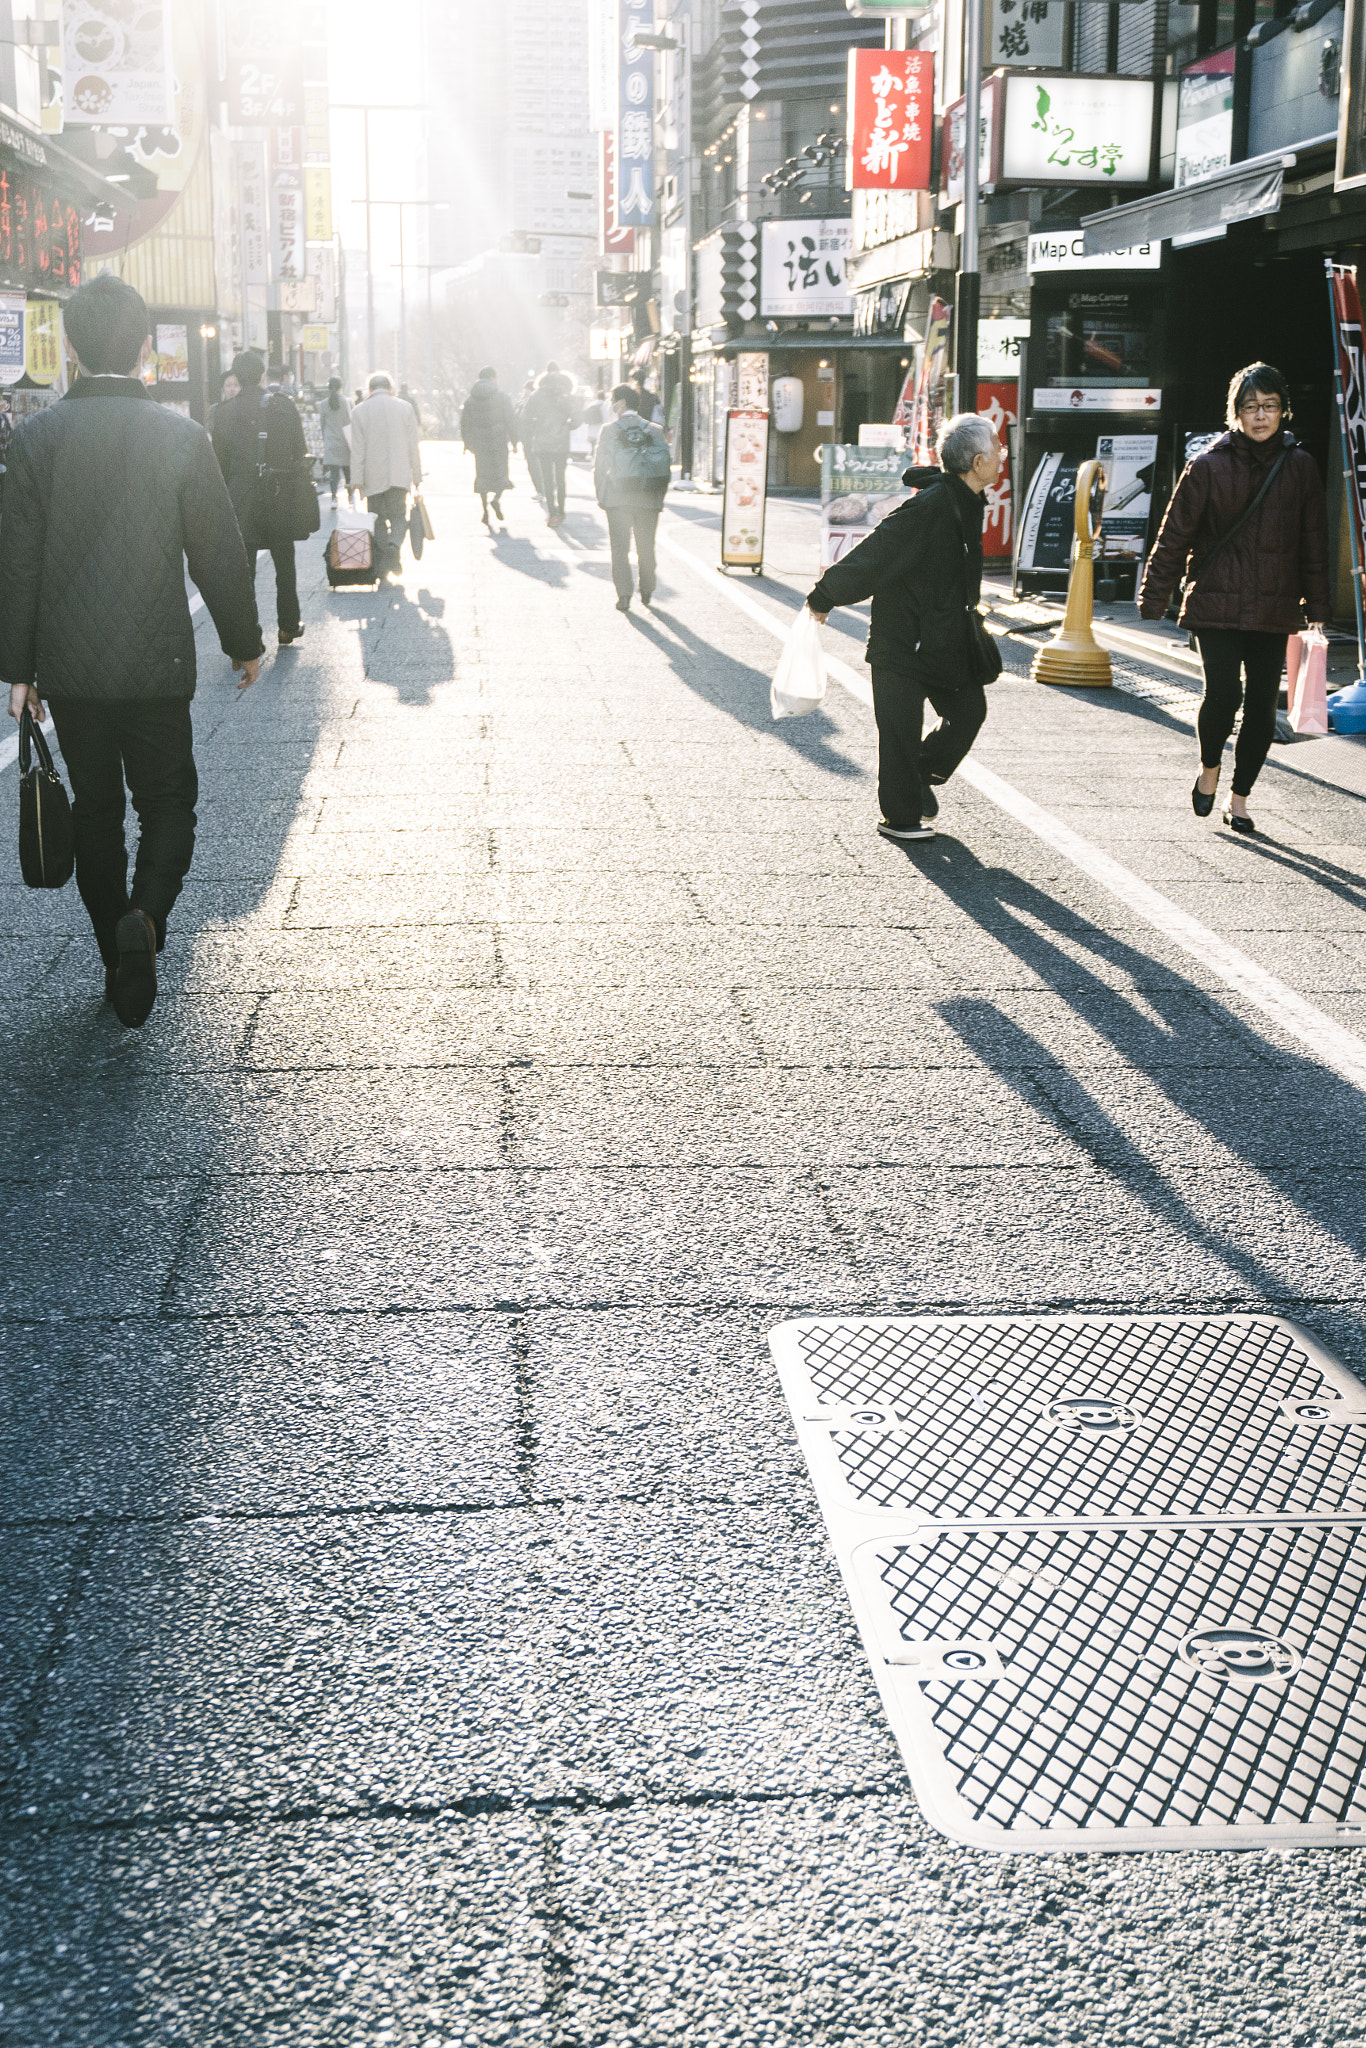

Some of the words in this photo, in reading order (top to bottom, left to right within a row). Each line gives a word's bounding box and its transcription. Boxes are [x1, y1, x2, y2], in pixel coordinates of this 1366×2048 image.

[861, 65, 909, 184] かど新
[902, 56, 923, 141] 活魚・串焼
[1031, 85, 1123, 176] ふらんす亭
[783, 236, 849, 291] 活い
[1040, 241, 1067, 262] Map
[1071, 239, 1151, 256] Cera
[1033, 470, 1054, 519] KINGDOM
[1027, 522, 1038, 550] NOTE
